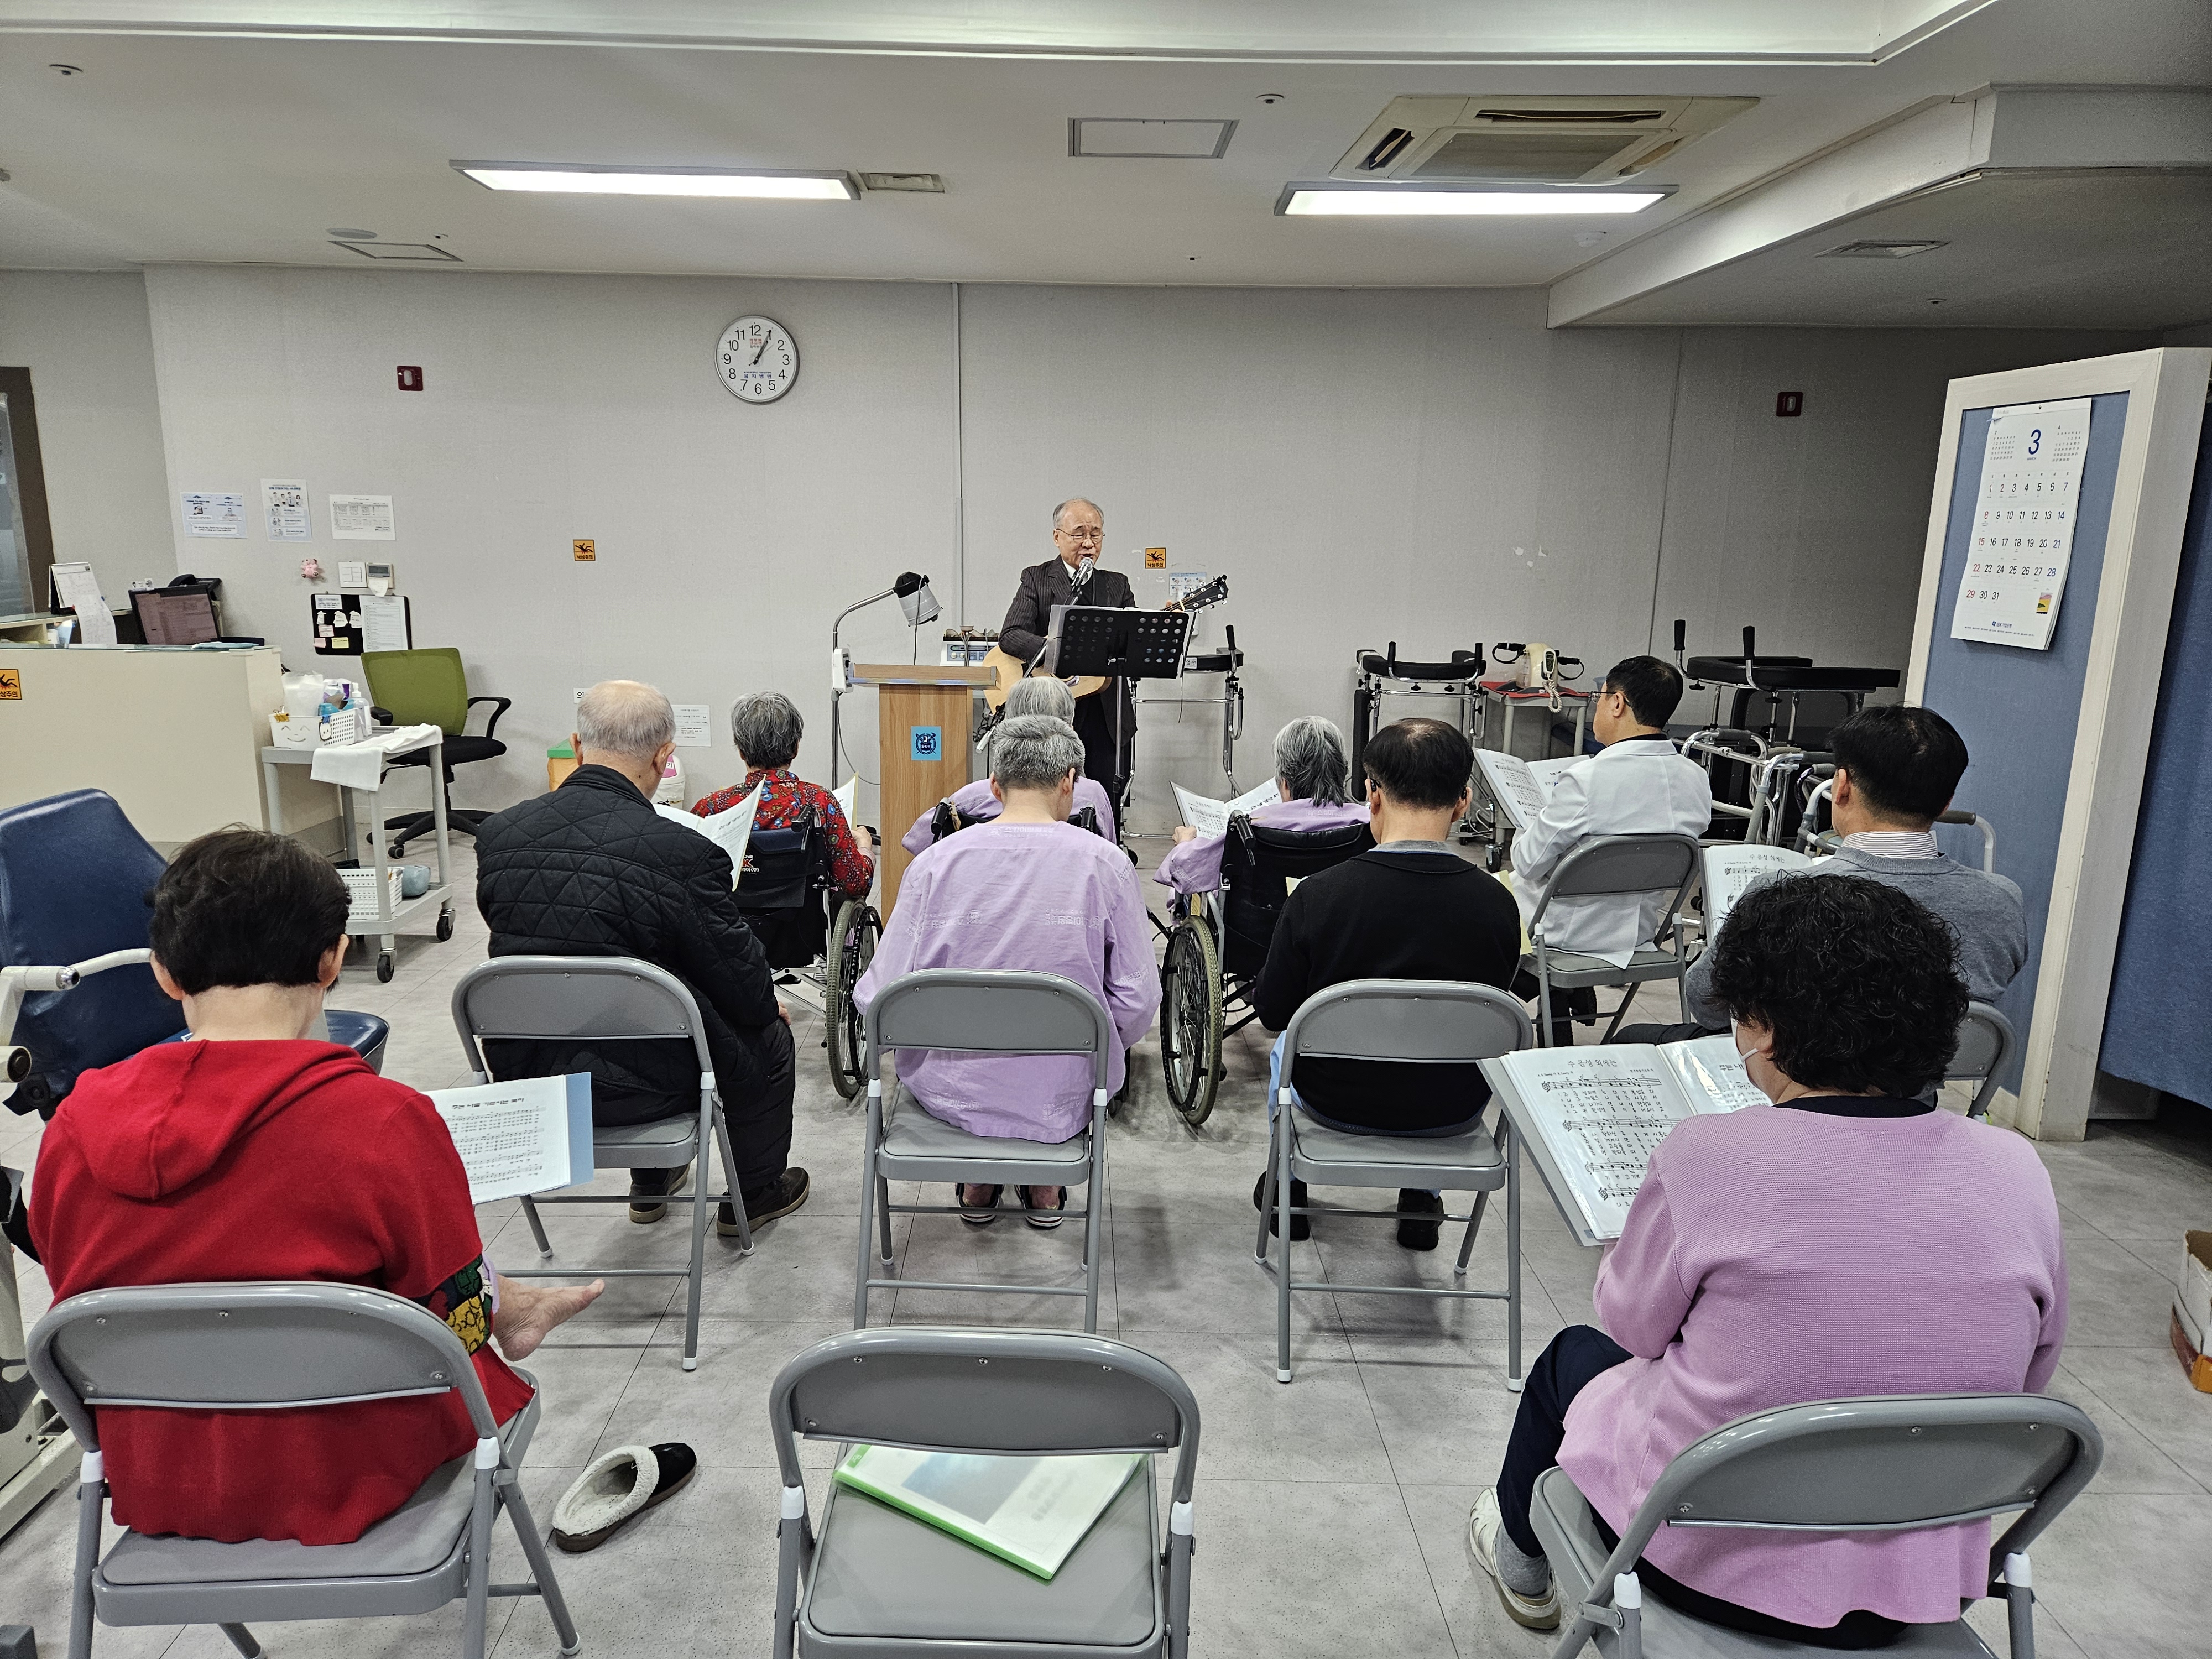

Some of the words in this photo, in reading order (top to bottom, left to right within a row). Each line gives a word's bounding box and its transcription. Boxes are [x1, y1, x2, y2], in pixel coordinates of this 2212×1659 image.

[735, 329, 745, 340] 11
[749, 325, 761, 336] 12
[766, 330, 771, 340] 1
[727, 340, 739, 351] 10
[778, 340, 784, 351] 2
[723, 353, 731, 364] 9
[782, 354, 790, 366] 3
[729, 368, 736, 379] 8
[778, 369, 786, 380] 4
[740, 379, 748, 390] 7
[754, 383, 762, 394] 6
[768, 380, 776, 390] 5
[2028, 429, 2041, 455] 3
[2000, 484, 2005, 492] 2
[2012, 484, 2017, 492] 3
[2024, 483, 2029, 492] 4
[2037, 483, 2042, 492] 5
[2050, 482, 2054, 491] 6
[2063, 482, 2068, 491] 7
[1984, 511, 1989, 519] 8
[1996, 511, 2001, 519] 9
[2007, 511, 2013, 519] 10
[2019, 511, 2026, 519] 11
[2032, 511, 2038, 520] 12
[2044, 511, 2052, 520] 13
[2058, 511, 2065, 520] 14
[1978, 538, 1985, 546] 15
[1990, 538, 1997, 546] 16
[2002, 538, 2008, 546] 17
[2014, 538, 2021, 547] 18
[2027, 539, 2034, 547] 19
[2039, 539, 2048, 548] 20
[2053, 540, 2061, 549] 21
[1973, 564, 1981, 572] 22
[1984, 564, 1992, 573] 23
[1996, 565, 2005, 573] 24
[2009, 566, 2017, 575] 25
[2021, 566, 2030, 575] 26
[2034, 567, 2042, 576] 27
[2047, 568, 2056, 577] 28
[1966, 589, 1975, 598] 29
[1979, 591, 1988, 599] 30
[1992, 592, 2000, 601] 31
